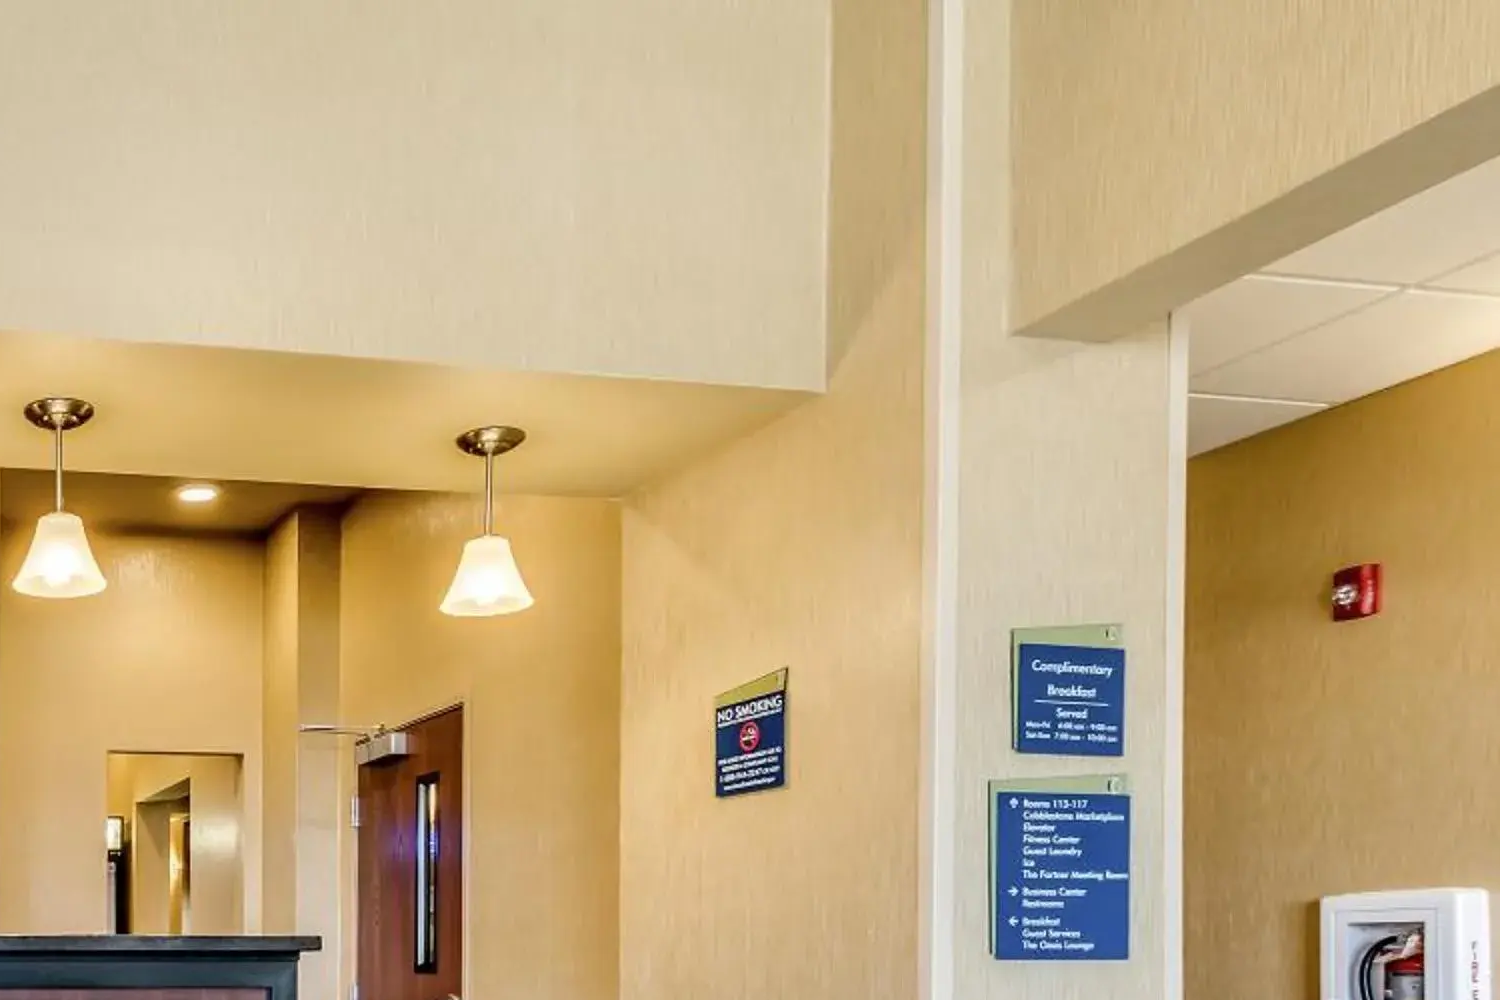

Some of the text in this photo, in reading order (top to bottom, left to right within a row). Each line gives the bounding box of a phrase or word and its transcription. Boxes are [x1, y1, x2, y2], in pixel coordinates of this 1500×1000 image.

[1031, 659, 1113, 678] Complimentary
[1047, 684, 1097, 698] Breakfast
[717, 695, 783, 723] NO SMOKING
[1056, 707, 1088, 719] Served
[1023, 799, 1051, 808] Rooms
[1023, 811, 1074, 820] Cobblestone
[1023, 822, 1056, 832] Elevator
[1023, 834, 1081, 844] Fitness Center
[1023, 846, 1083, 857] Guest Laundry
[1023, 858, 1035, 867] Ice
[1022, 869, 1038, 878] The
[1070, 871, 1103, 881] Meeting
[1022, 886, 1088, 896] Business Center
[1022, 899, 1064, 908] Restrooms
[1022, 916, 1060, 926] Breakfast
[1022, 929, 1081, 938] Guest Services
[1022, 940, 1095, 952] The Oasis Lounge
